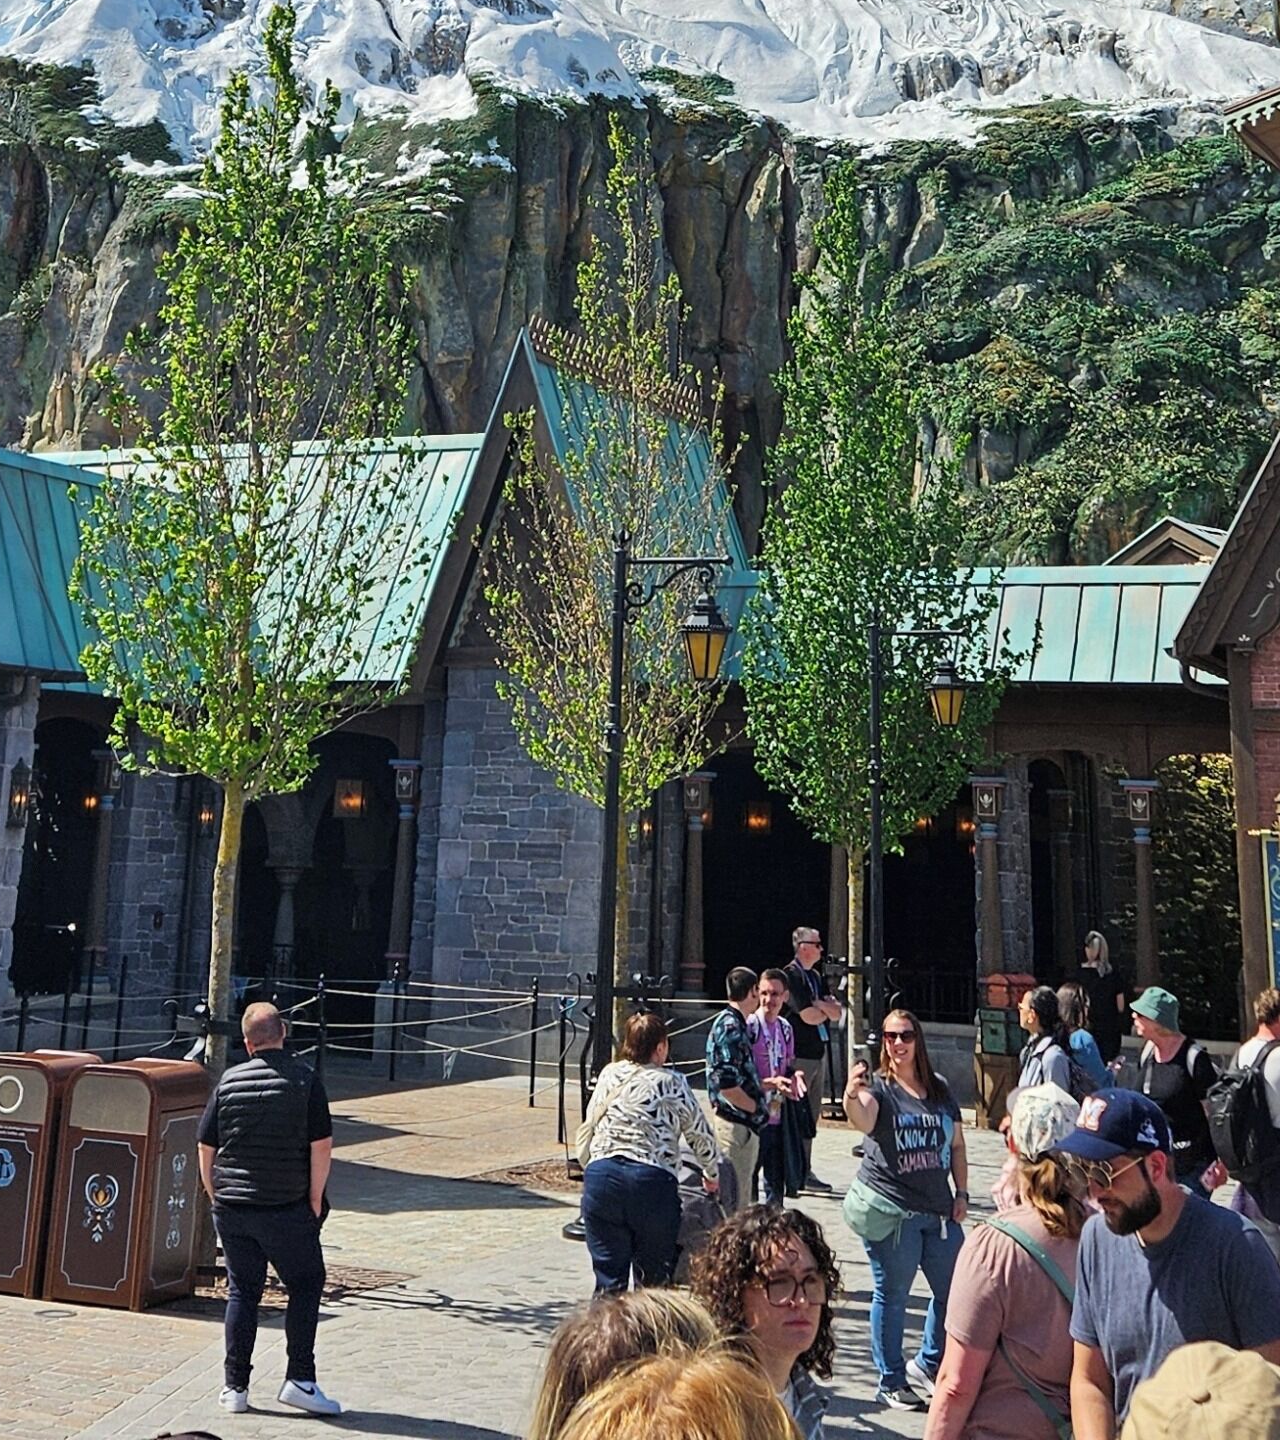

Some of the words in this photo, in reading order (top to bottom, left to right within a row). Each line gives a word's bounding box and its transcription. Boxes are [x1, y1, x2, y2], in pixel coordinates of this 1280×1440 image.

[1076, 1096, 1108, 1131] M
[894, 1128, 928, 1152] KNOW
[930, 1129, 938, 1147] A
